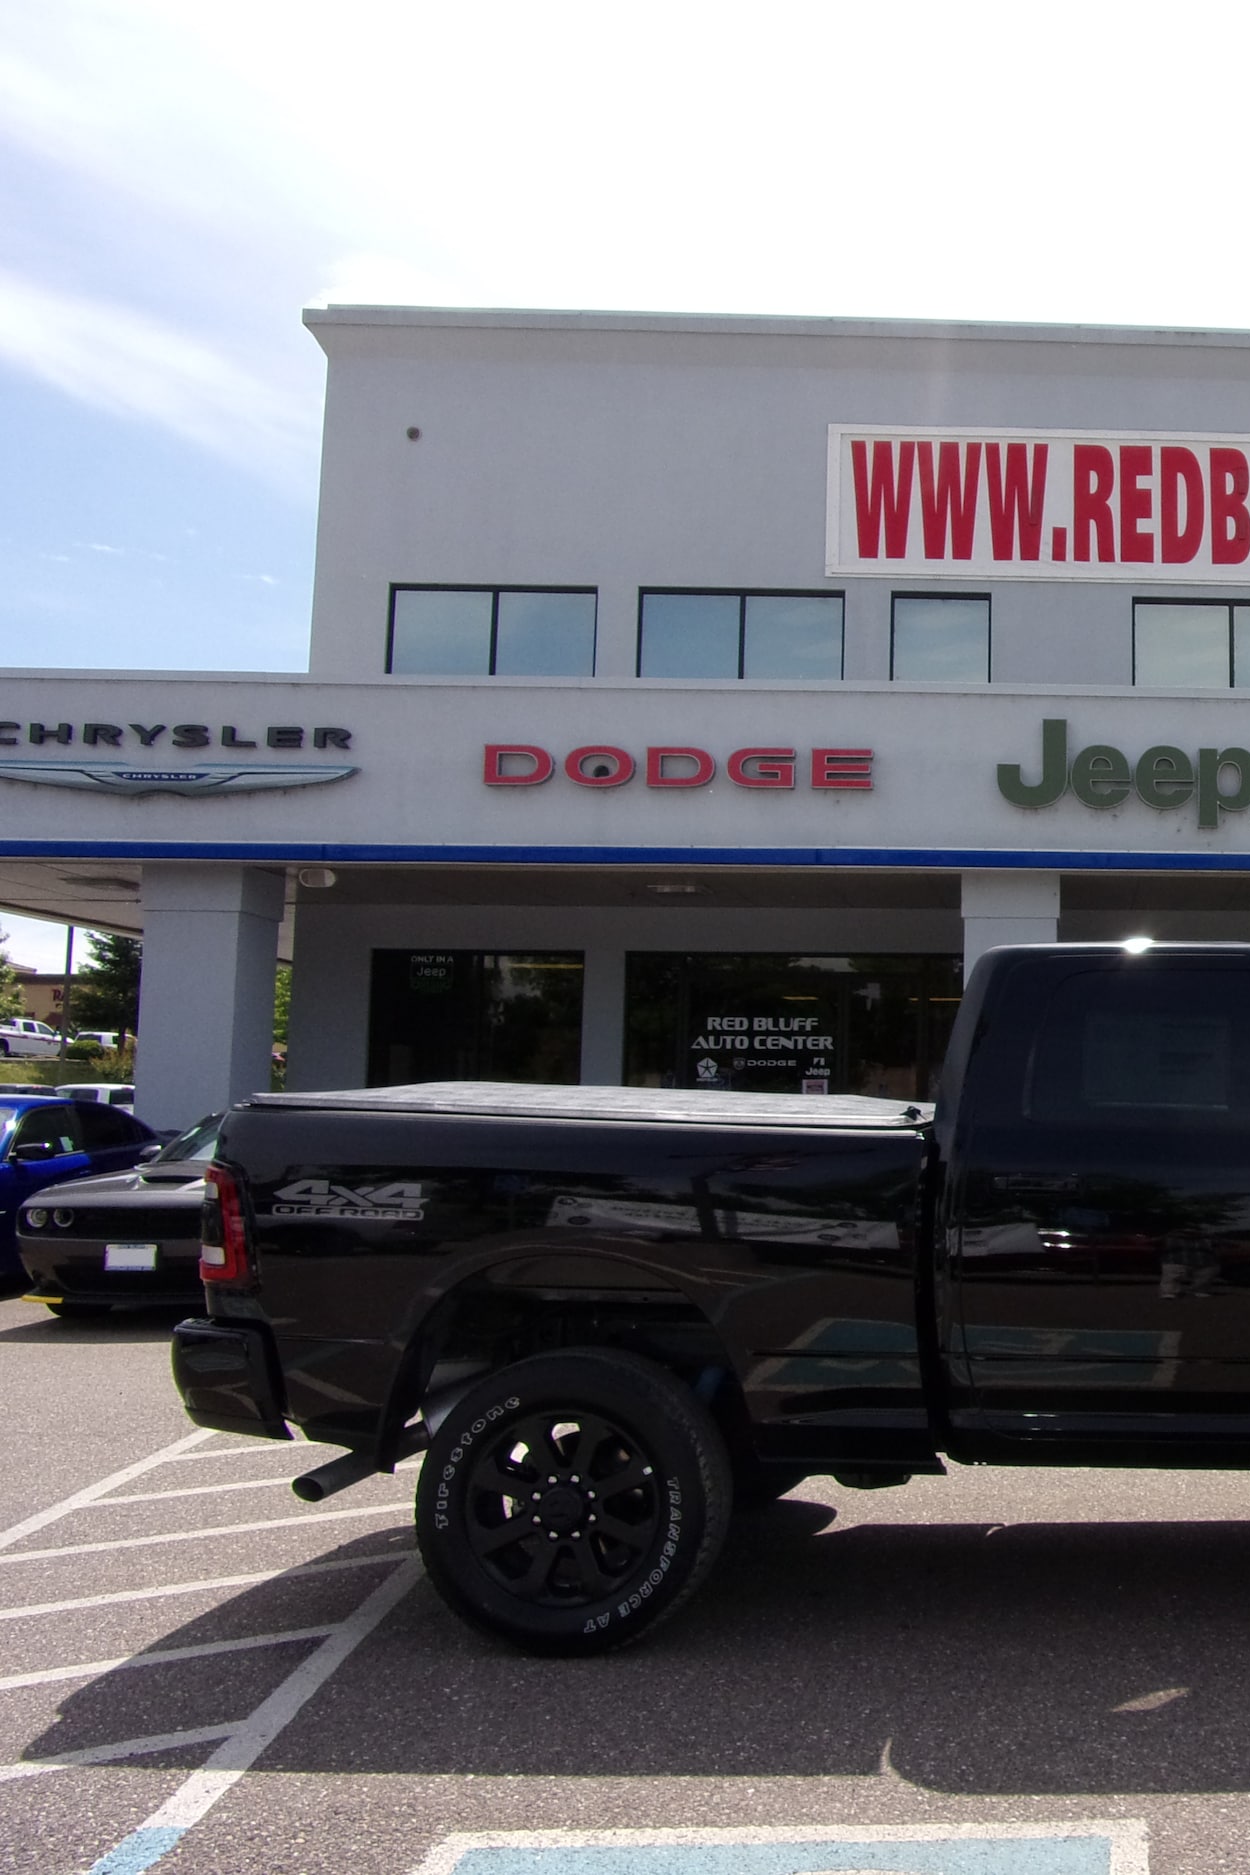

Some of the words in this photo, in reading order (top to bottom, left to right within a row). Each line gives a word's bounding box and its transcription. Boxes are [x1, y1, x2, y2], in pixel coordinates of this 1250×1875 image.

[483, 744, 873, 790] DODGE
[410, 955, 434, 963] ONLY
[436, 955, 446, 963] IN
[447, 955, 454, 964] A
[416, 966, 447, 978] Jeep
[707, 1016, 749, 1031] RED
[753, 1017, 819, 1031] BLUFF
[691, 1035, 749, 1049] AUTO
[753, 1036, 834, 1050] CENTER
[747, 1059, 797, 1067] DODGE
[805, 1067, 830, 1076] Jeep
[275, 1206, 332, 1215] OFF
[340, 1207, 421, 1219] ROAD
[618, 1477, 682, 1618] TRANSFORCE
[583, 1612, 611, 1634] AT
